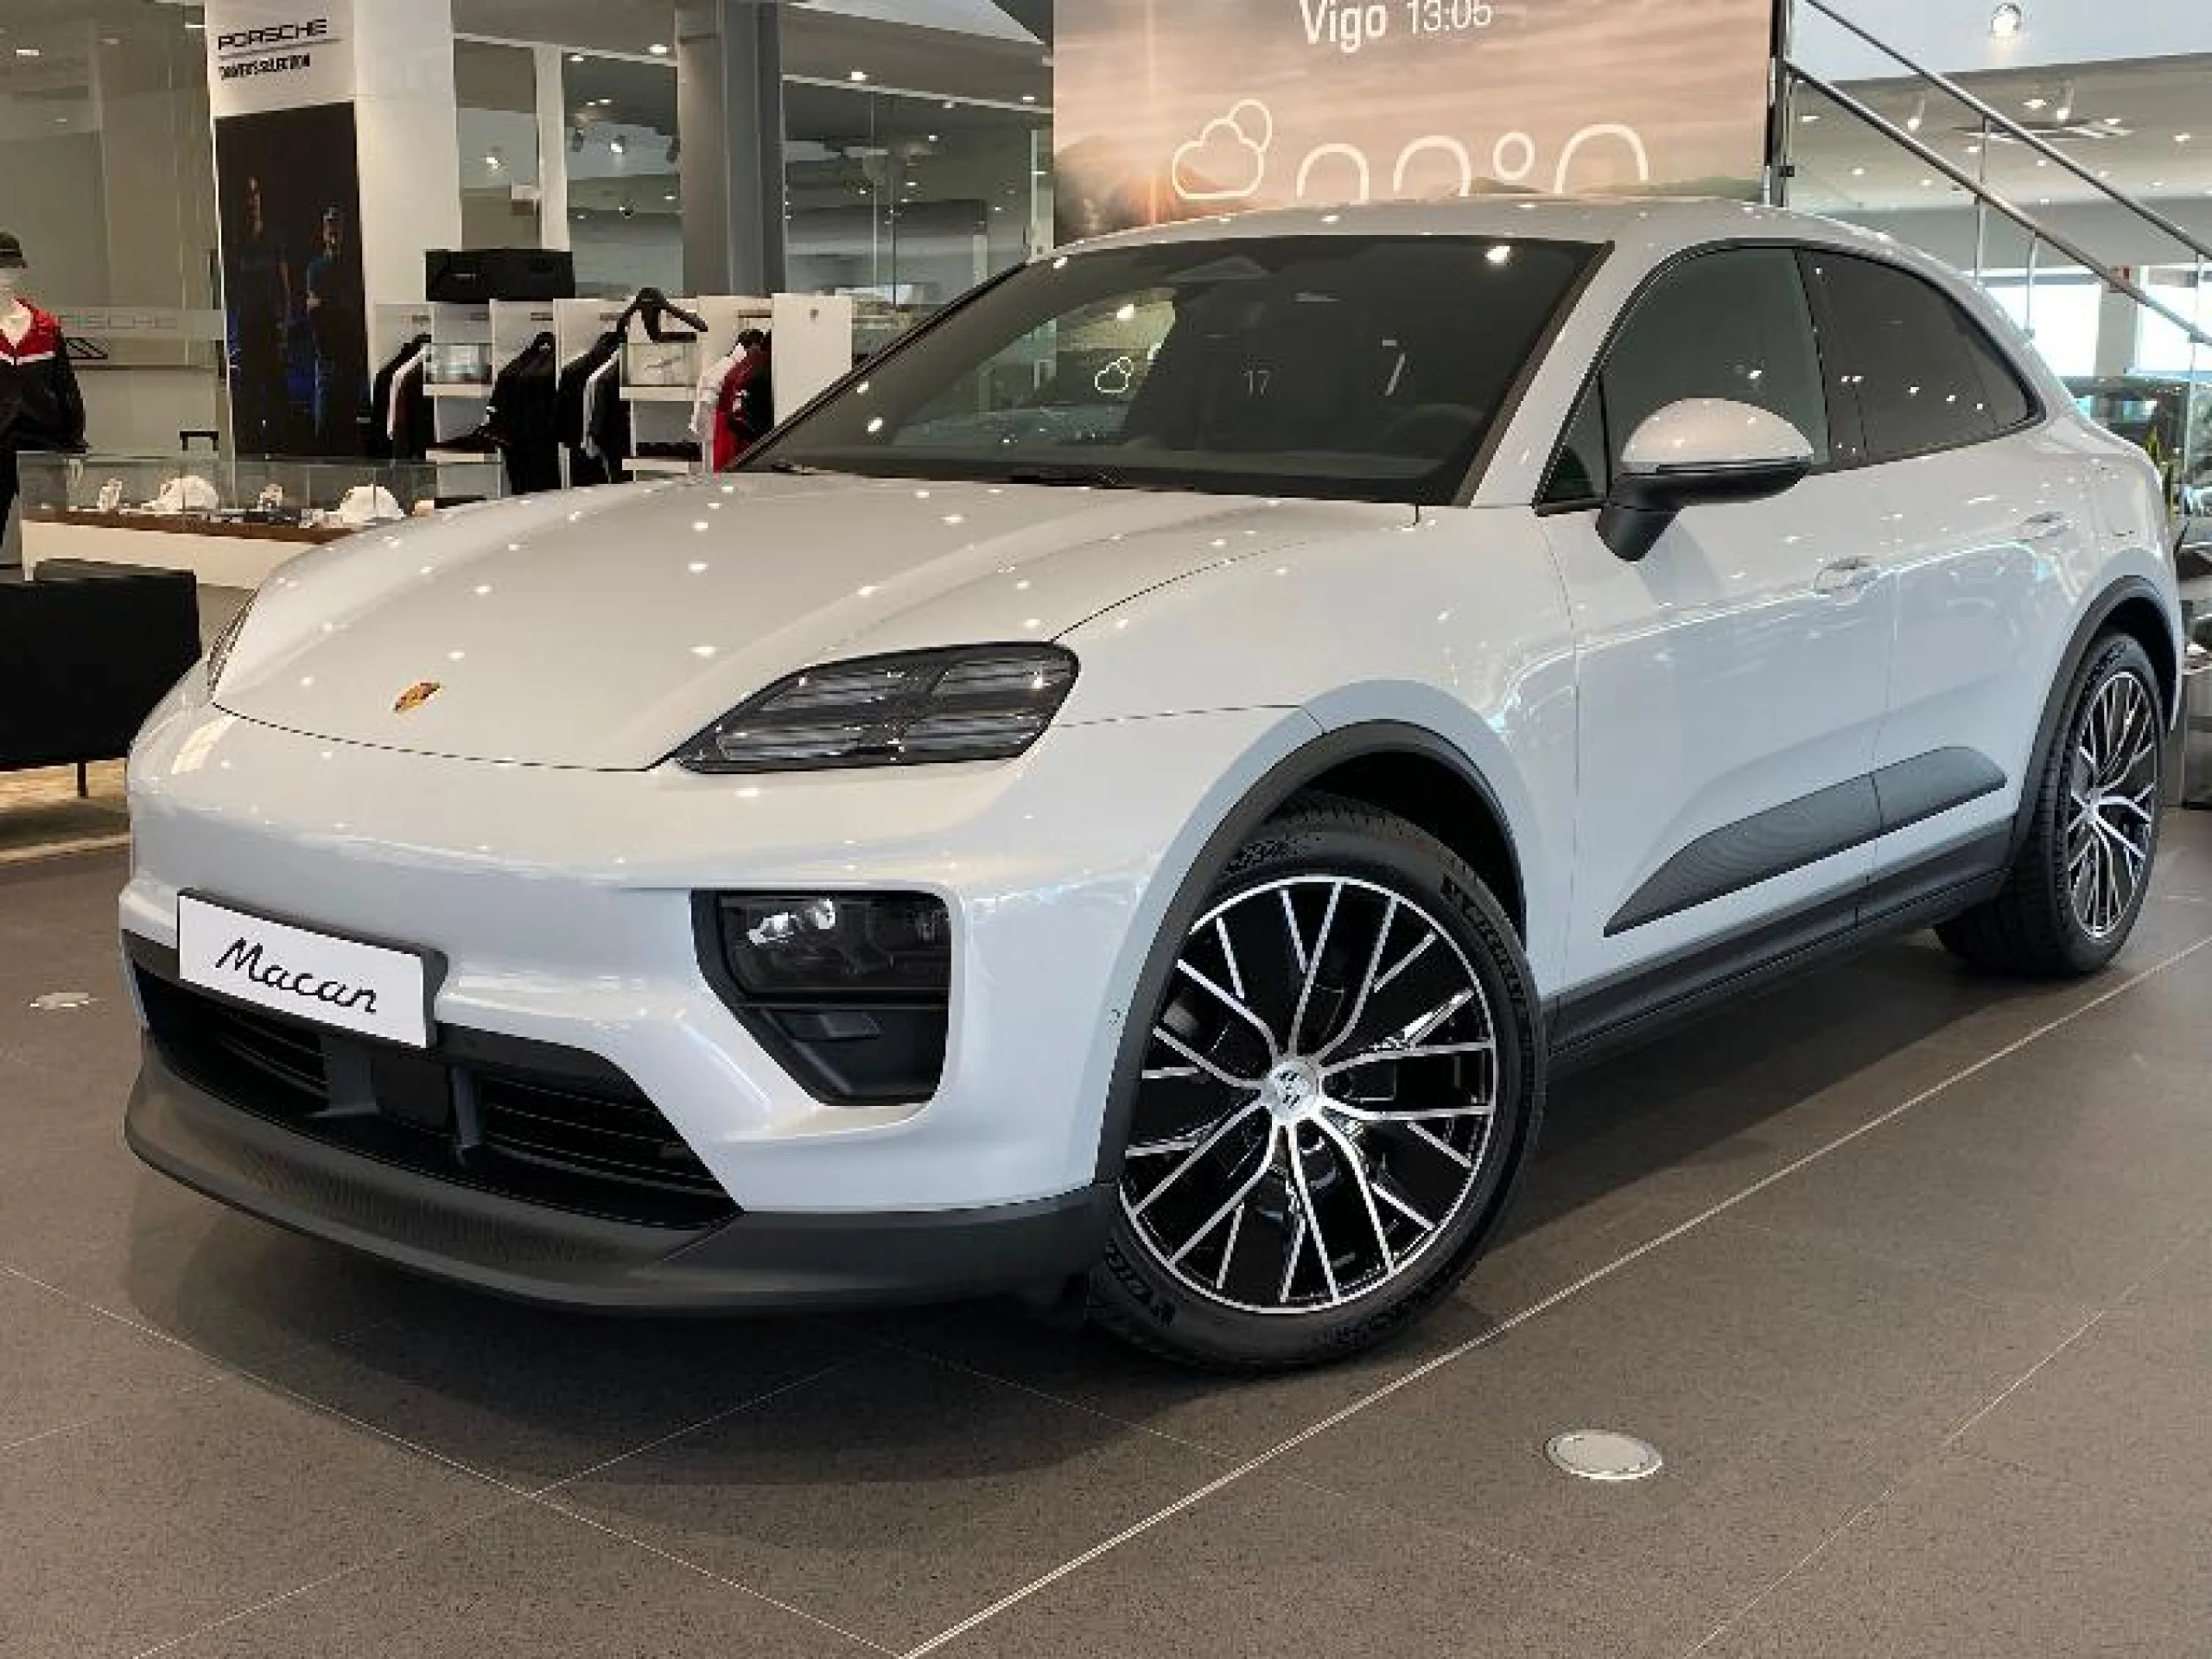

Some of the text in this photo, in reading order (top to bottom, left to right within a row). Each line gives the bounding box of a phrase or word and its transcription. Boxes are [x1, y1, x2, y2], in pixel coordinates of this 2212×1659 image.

[218, 18, 327, 50] PORSCHE
[1300, 0, 1386, 53] Vigo
[215, 937, 377, 1014] Macan
